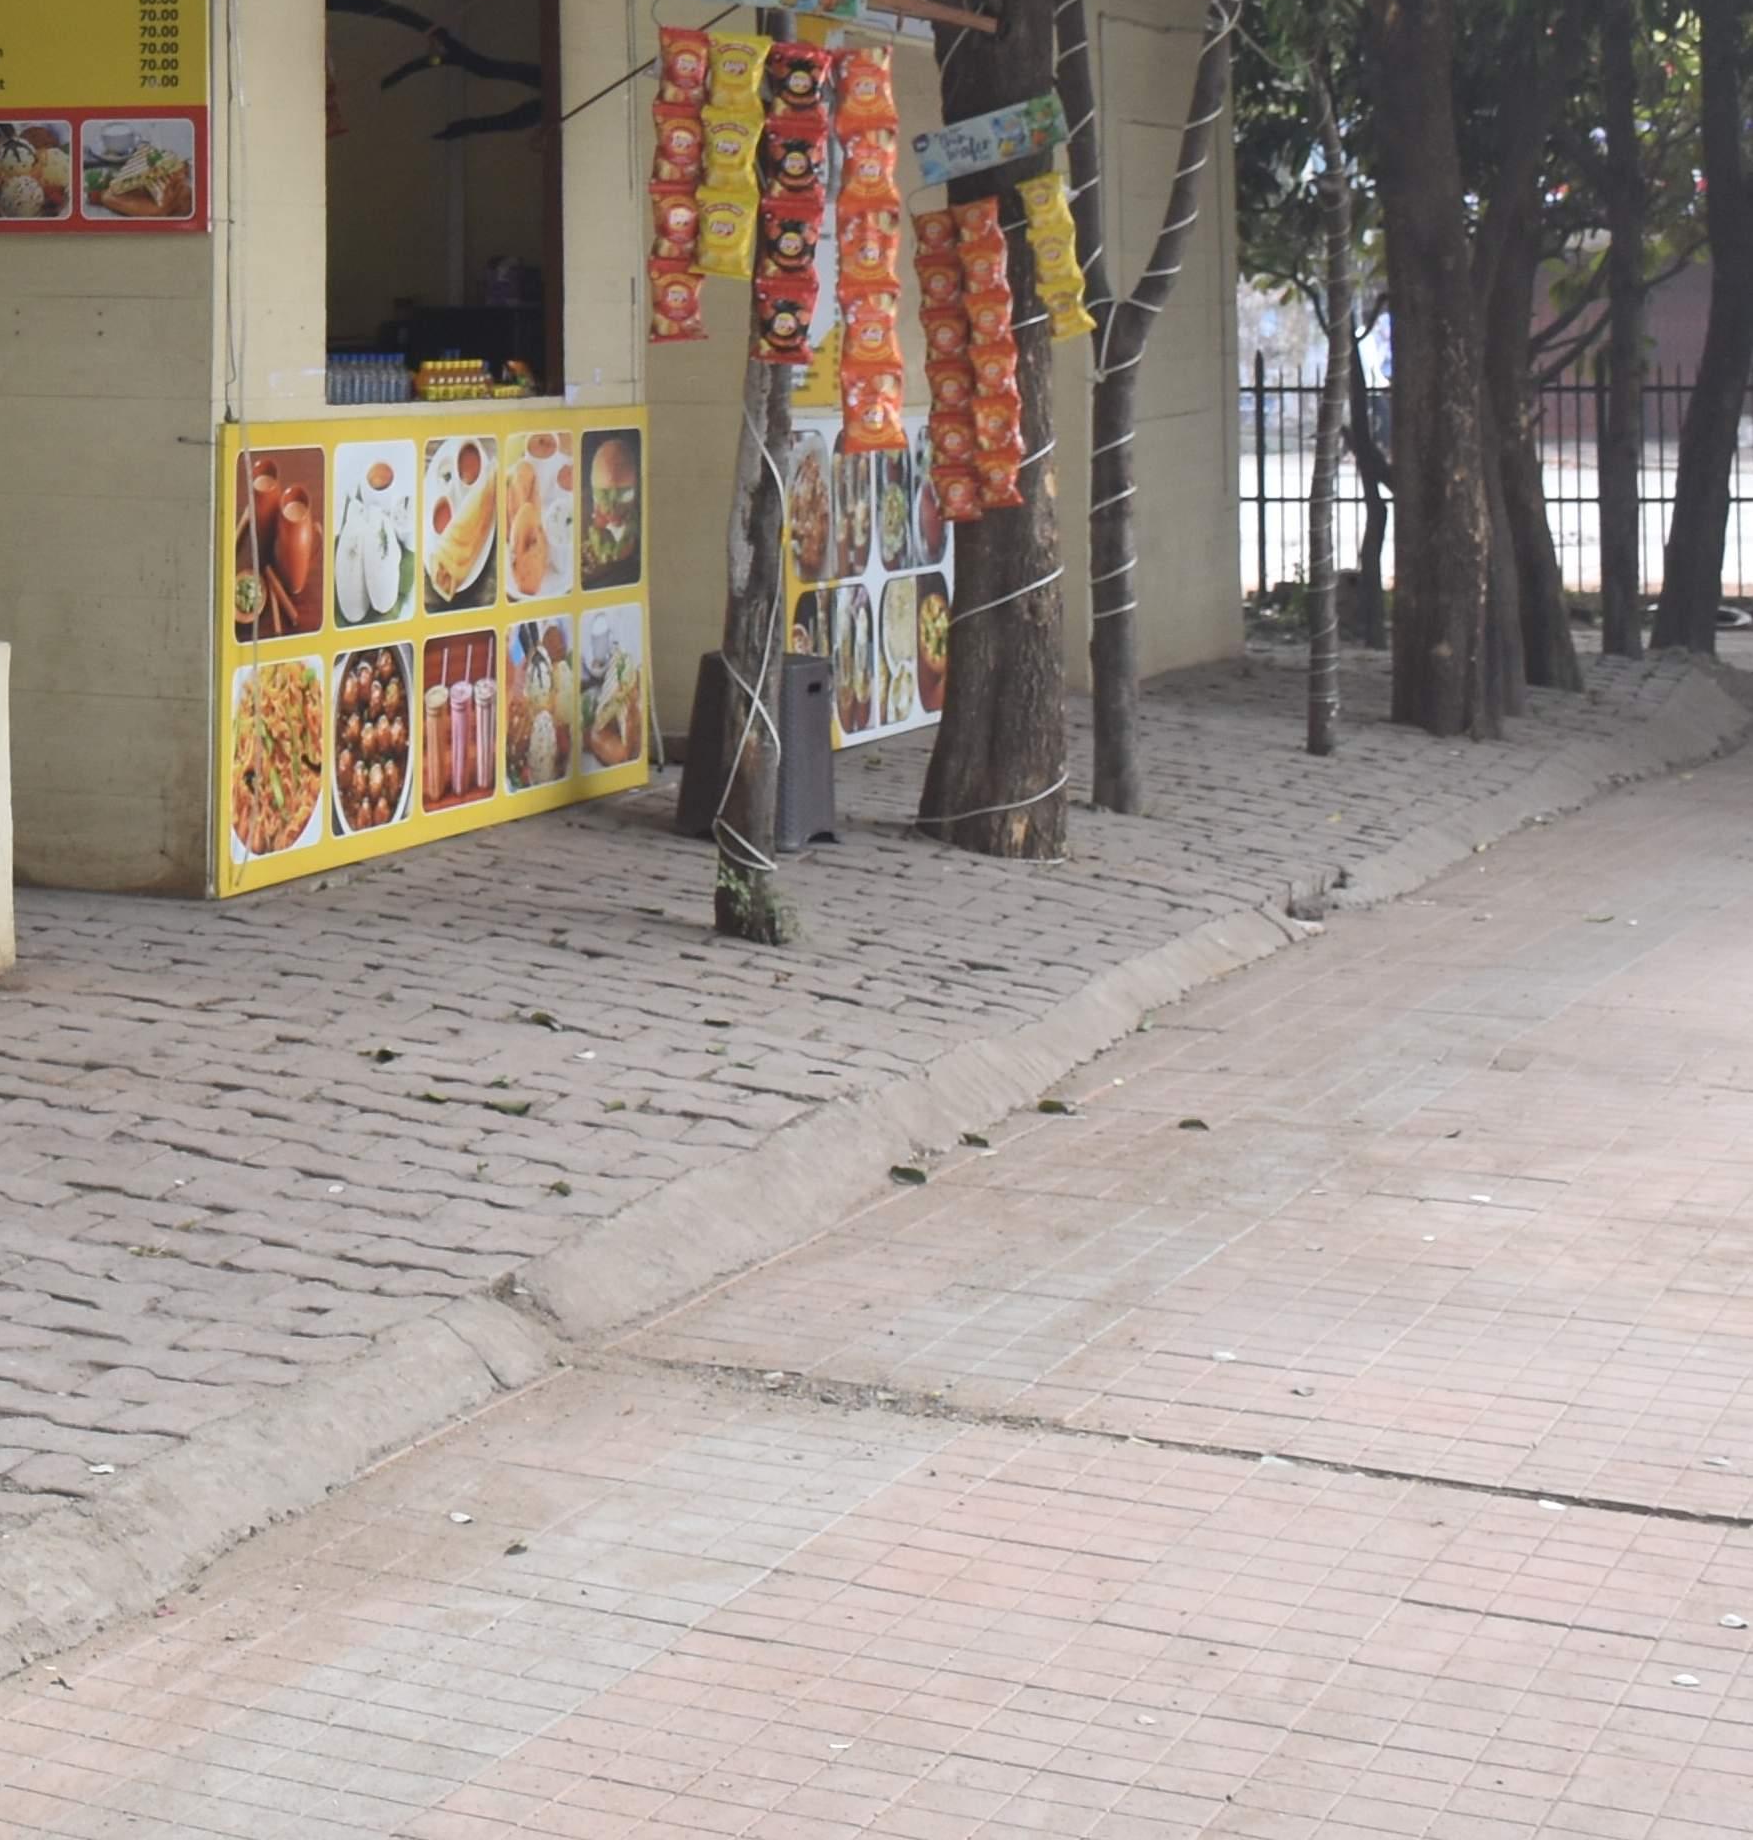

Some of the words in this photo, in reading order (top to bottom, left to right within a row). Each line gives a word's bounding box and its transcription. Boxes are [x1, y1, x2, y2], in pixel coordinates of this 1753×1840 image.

[140, 10, 179, 21] 70.00
[140, 26, 179, 37] 70.00
[140, 43, 179, 54] 70.00
[141, 60, 179, 71] 70.00
[141, 76, 179, 88] 70.00
